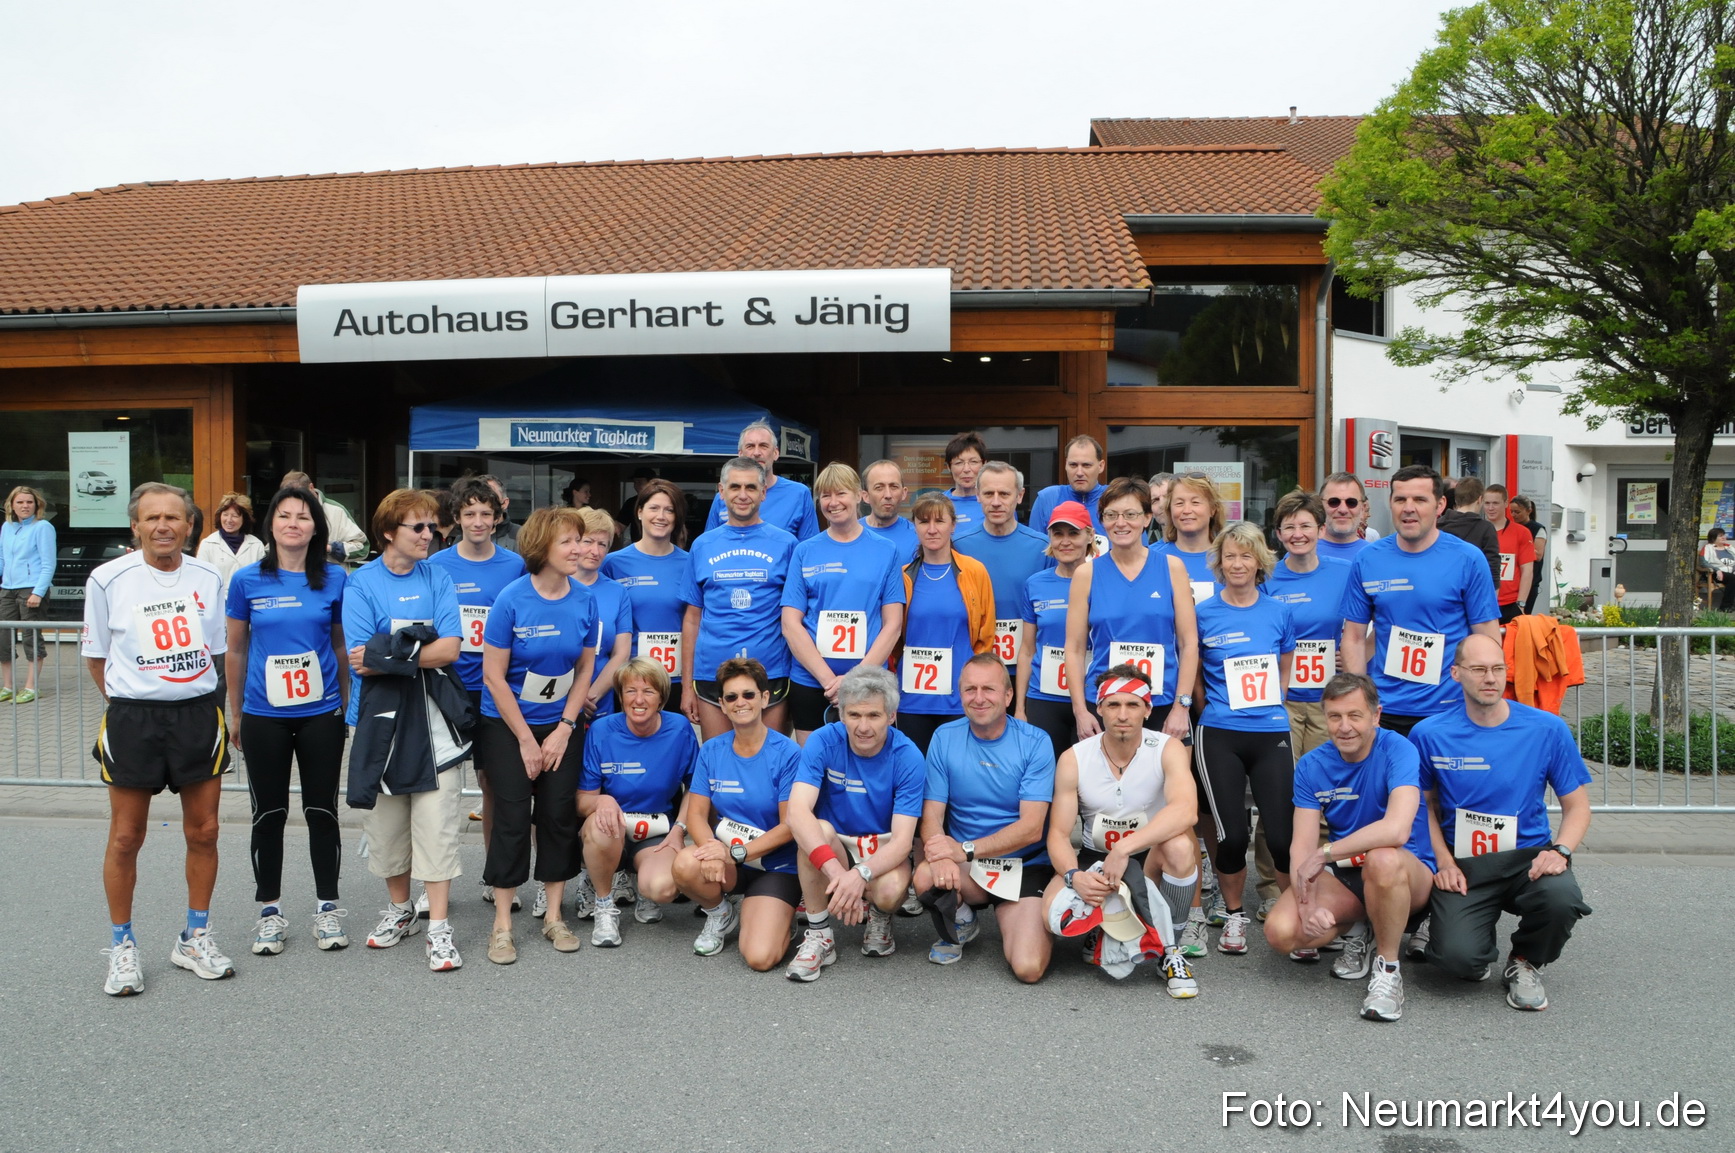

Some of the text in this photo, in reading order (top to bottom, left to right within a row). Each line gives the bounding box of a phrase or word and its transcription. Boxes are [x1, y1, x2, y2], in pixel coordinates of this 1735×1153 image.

[333, 294, 911, 337] Autohaus Gerhart & Jänig
[518, 426, 648, 446] Neumarkter Tagblatt
[1364, 479, 1391, 488] SEA
[708, 548, 774, 566] funrunners
[143, 602, 173, 613] MEYER
[145, 608, 175, 618] WERBUNG
[151, 615, 191, 651] 86
[832, 624, 856, 653] 21
[1398, 630, 1423, 642] MEYER
[1398, 636, 1423, 647] WERBUNG
[136, 650, 200, 666] GERHART
[274, 658, 300, 666] MEYER
[650, 646, 676, 673] 65
[1233, 659, 1259, 667] MEYER
[1400, 645, 1427, 677] 16
[913, 663, 938, 691] 72
[1295, 655, 1325, 683] 55
[282, 669, 310, 699] 13
[539, 678, 557, 700] 4
[1241, 672, 1268, 702] 67
[1102, 818, 1127, 826] MEYER
[1465, 812, 1492, 824] MEYER
[1465, 819, 1493, 829] WERBUNG
[633, 820, 648, 840] 9
[727, 822, 749, 834] MEYER
[1105, 830, 1135, 851] 8
[1471, 830, 1499, 857] 61
[978, 858, 1001, 866] MEYER
[986, 871, 1000, 889] 7
